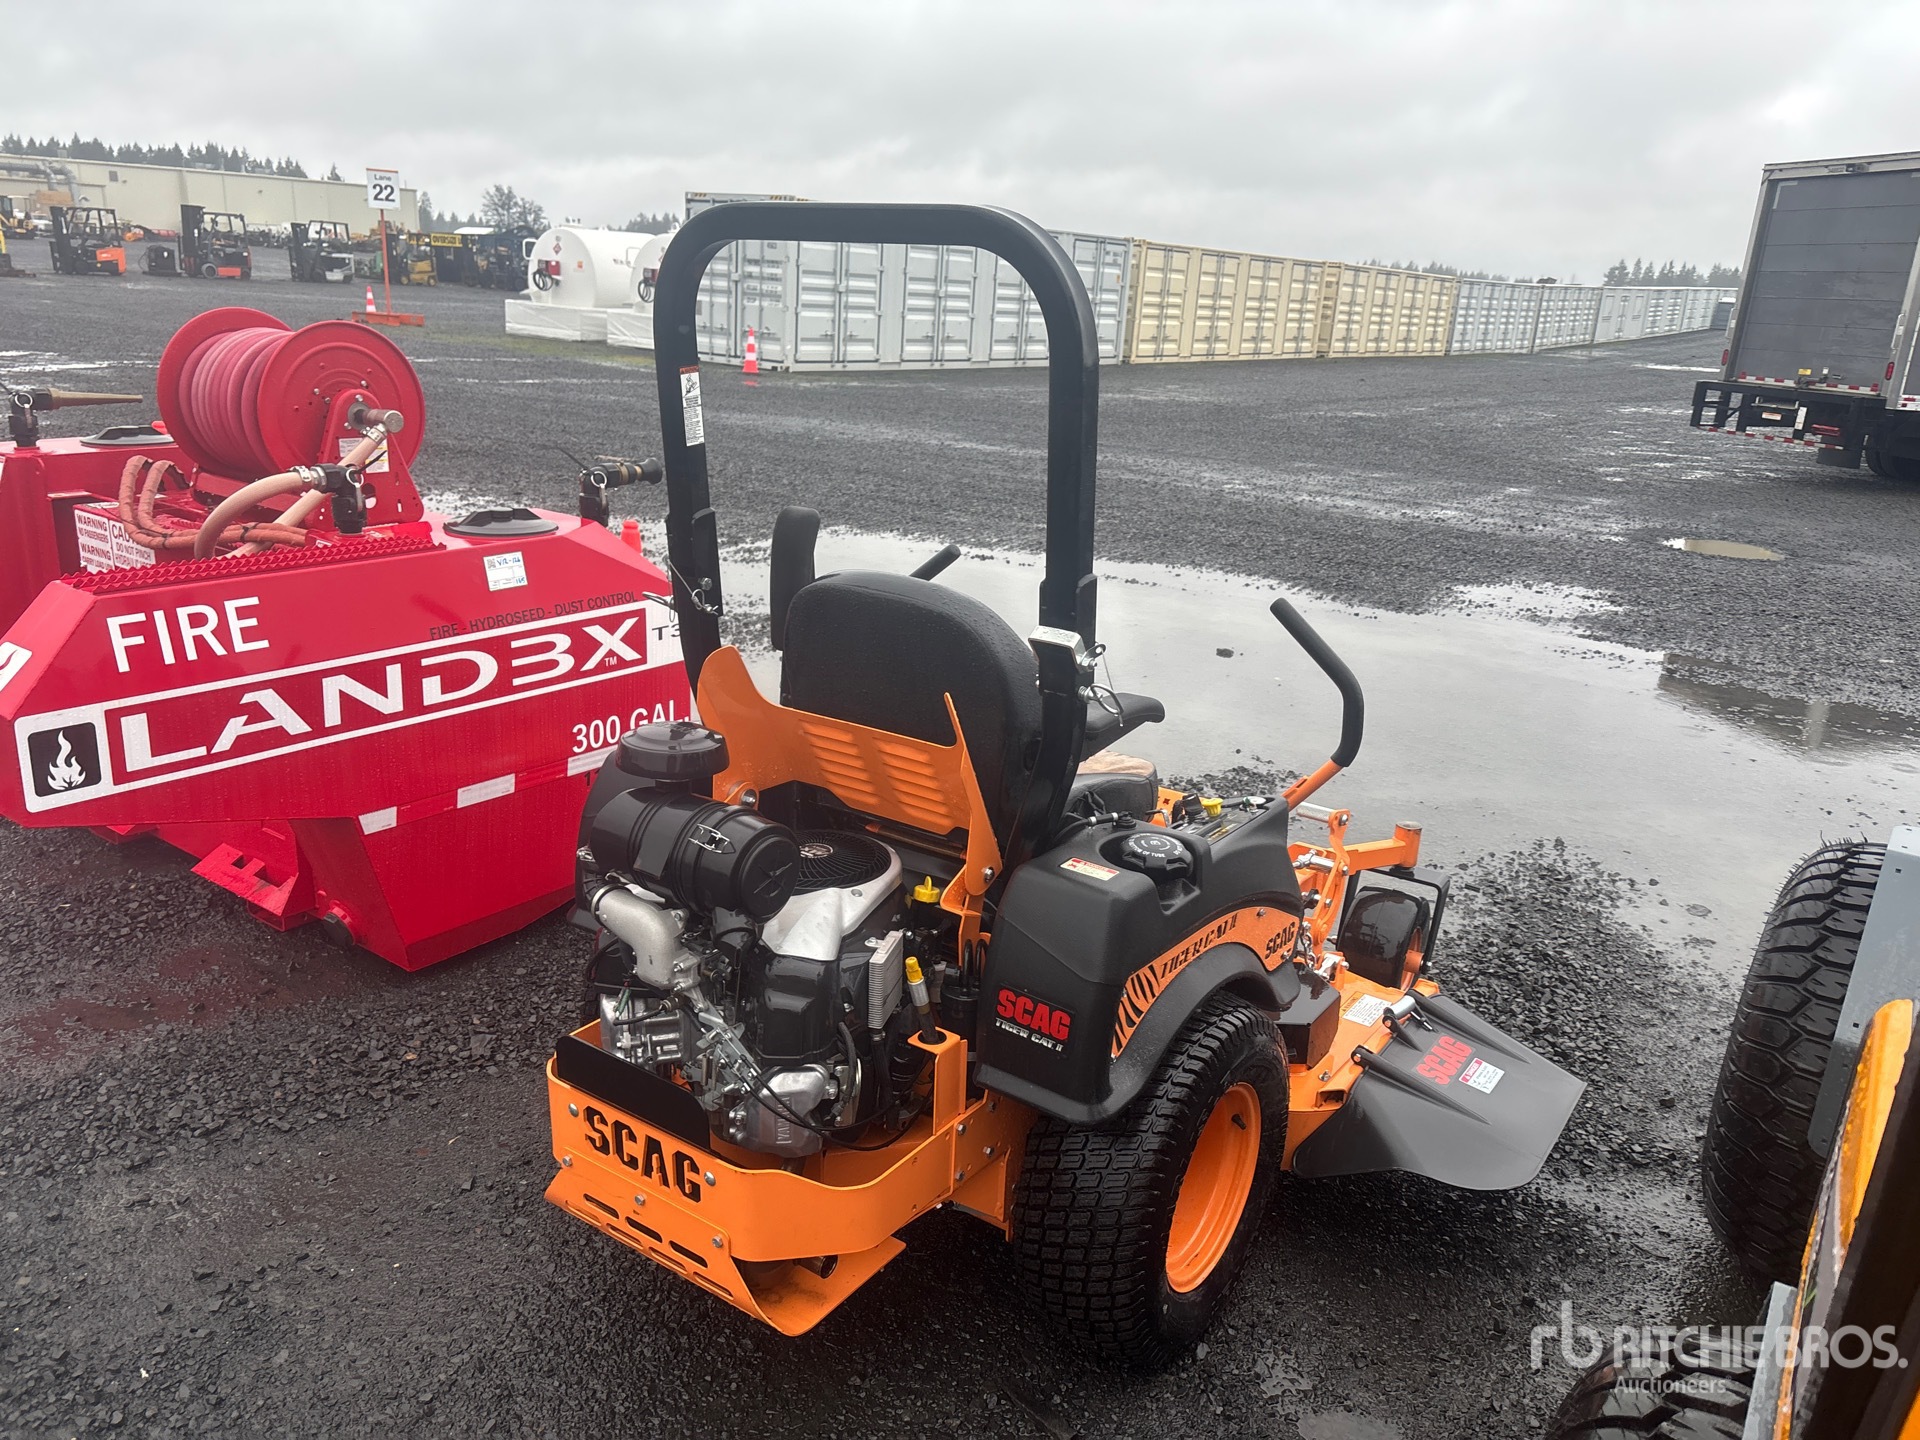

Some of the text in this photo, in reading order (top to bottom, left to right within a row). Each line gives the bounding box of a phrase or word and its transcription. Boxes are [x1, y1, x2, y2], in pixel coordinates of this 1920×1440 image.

[372, 183, 396, 202] 22
[374, 173, 392, 182] Lane
[76, 513, 108, 532] WARNING
[80, 542, 111, 561] WARNING
[106, 596, 270, 673] FIRE
[430, 623, 458, 640] FIRE
[469, 607, 545, 631] HYDROSEED
[554, 597, 584, 616] DUST
[587, 591, 638, 610] CONTROL
[572, 715, 621, 753] 300
[1160, 936, 1203, 979] TIGER
[1264, 921, 1296, 960] SCAG
[995, 1017, 1030, 1039] TIGER
[996, 989, 1071, 1041] SCAG
[1416, 1035, 1473, 1085] SCAG
[583, 1105, 701, 1204] SCAG
